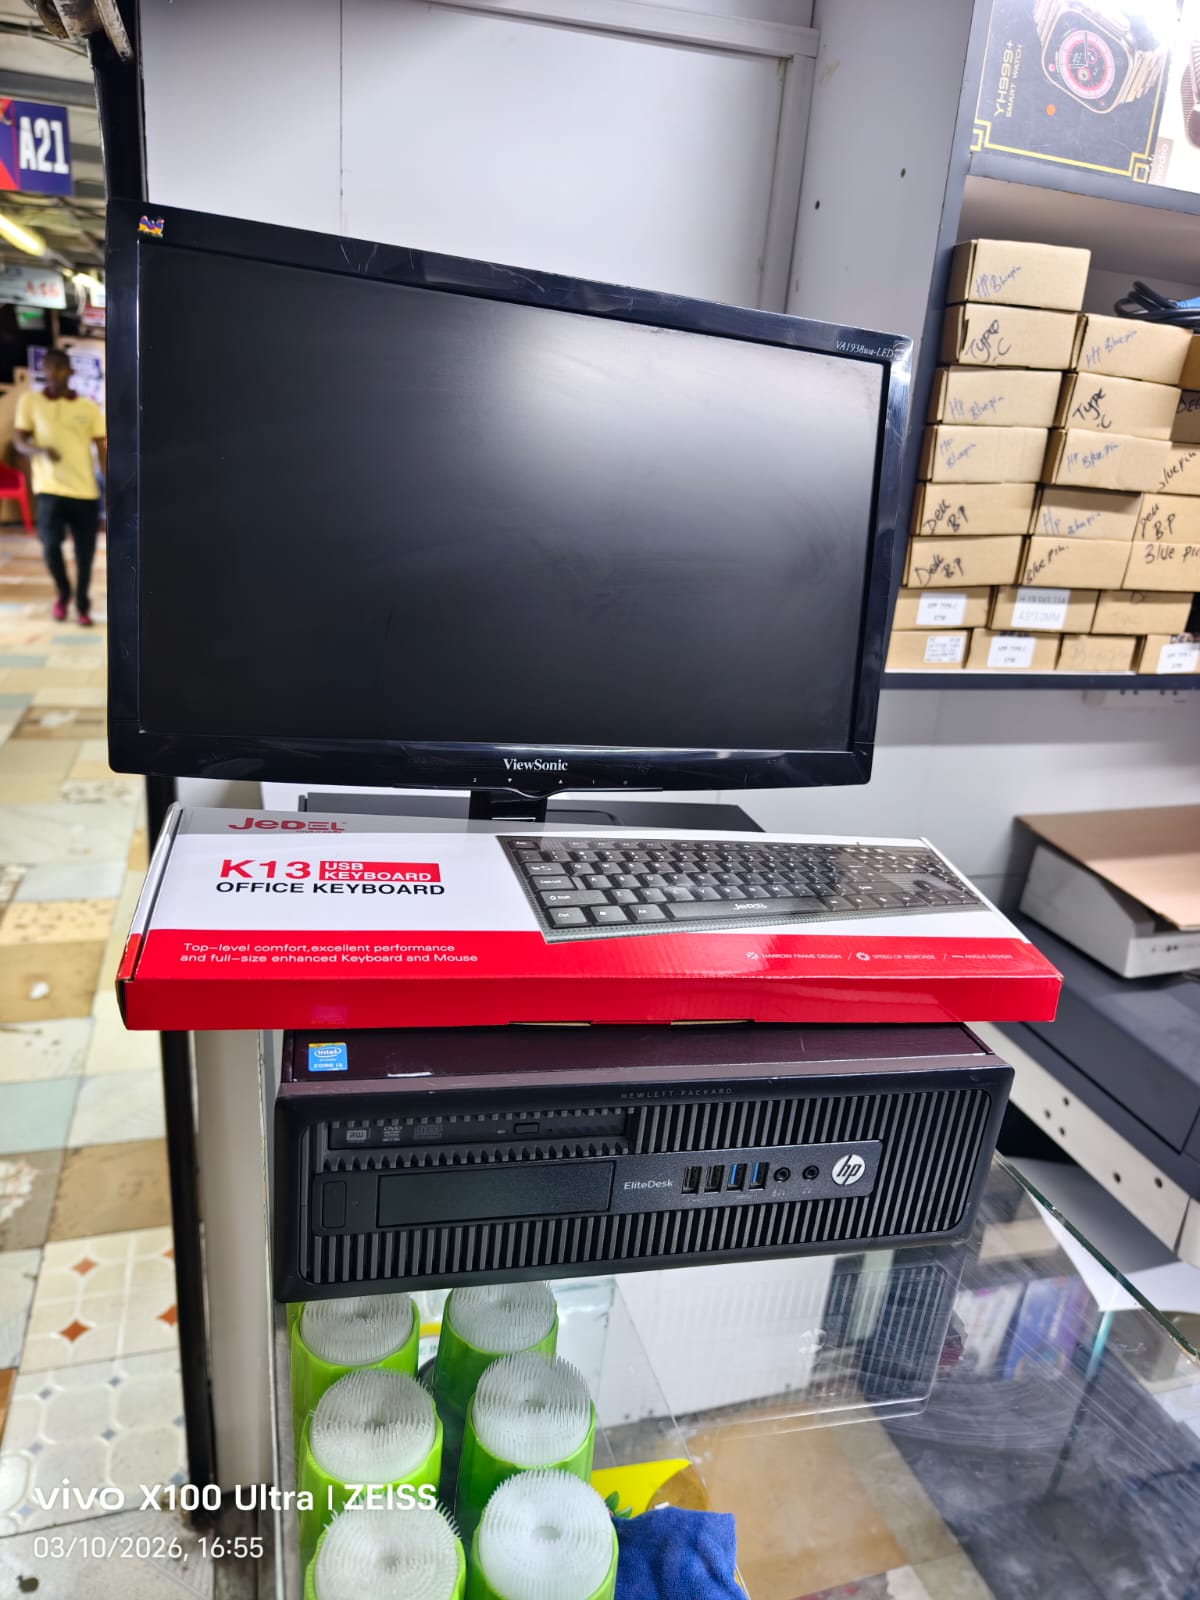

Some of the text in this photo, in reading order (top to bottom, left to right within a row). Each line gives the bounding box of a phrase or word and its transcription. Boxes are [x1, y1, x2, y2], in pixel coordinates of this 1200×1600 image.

[1005, 43, 1023, 118] SMART WATCH
[19, 115, 69, 175] A21
[965, 319, 1000, 364] Type
[1072, 387, 1106, 420] Type
[503, 758, 569, 771] ViewSonic
[219, 859, 312, 880] K13
[324, 862, 364, 871] USB
[324, 871, 433, 881] KEYBOARD
[215, 881, 446, 895] OFFICE KEYBOARD
[374, 944, 456, 953] performance
[180, 954, 479, 964] and full-size enhanced Keyboard and Mouse
[836, 1154, 863, 1185] hp
[623, 1179, 674, 1190] EliteDesk
